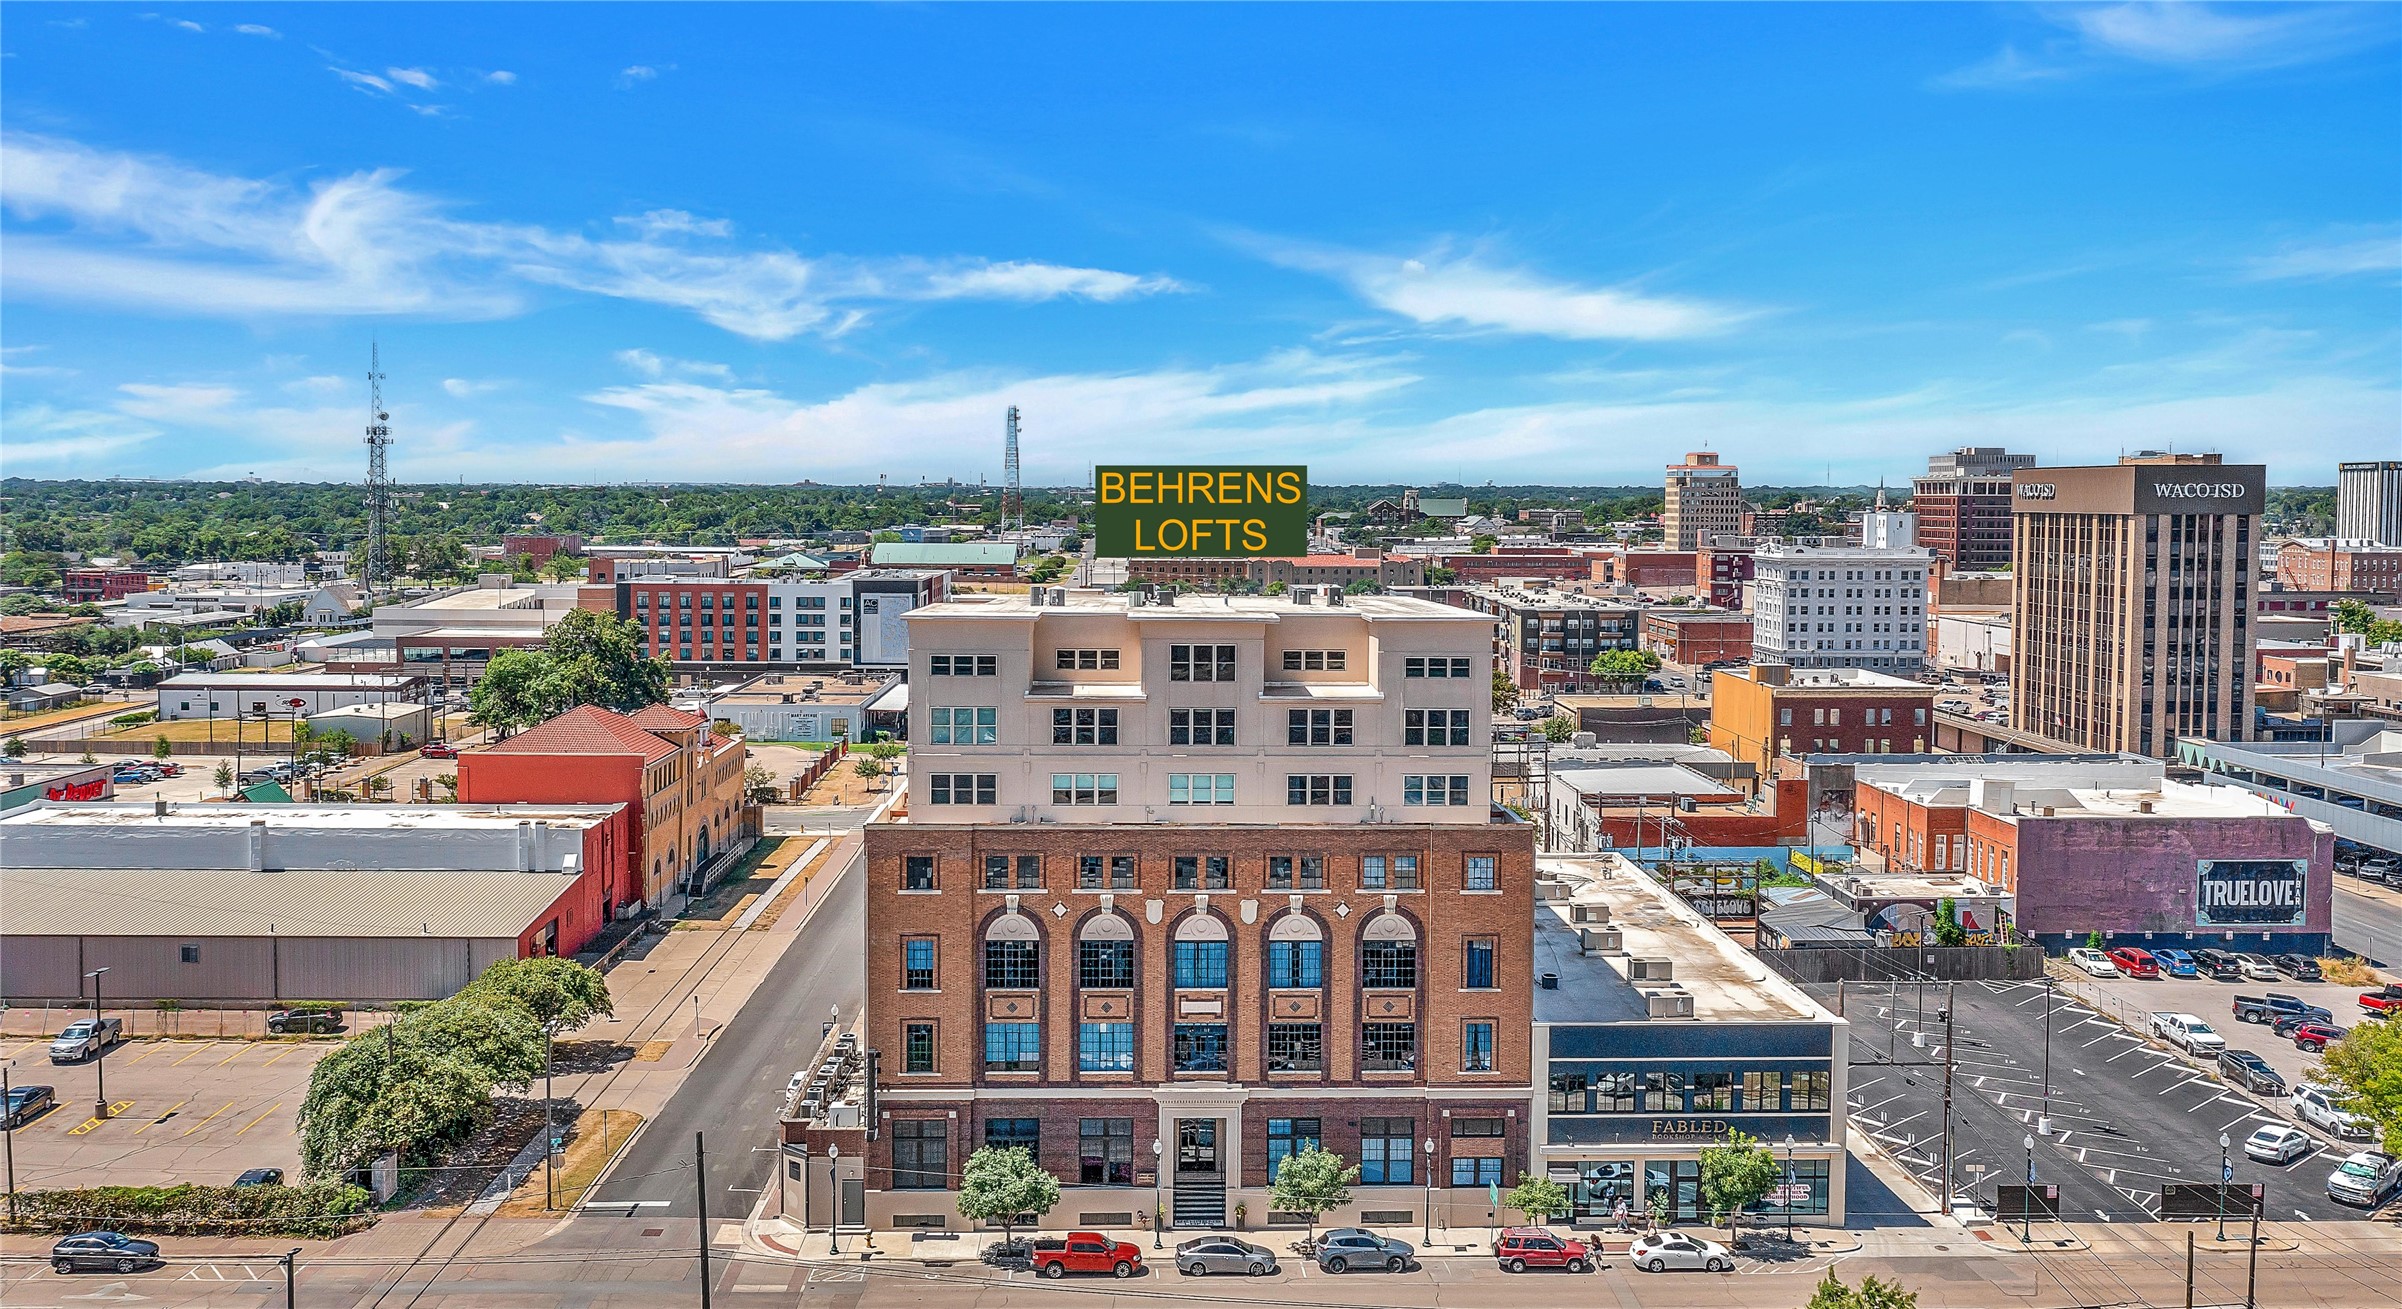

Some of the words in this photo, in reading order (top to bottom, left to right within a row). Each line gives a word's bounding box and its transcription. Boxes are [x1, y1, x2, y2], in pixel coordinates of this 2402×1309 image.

[2016, 483, 2040, 498] WACO
[2153, 482, 2210, 498] WACO
[2213, 482, 2245, 498] ISD
[864, 599, 878, 607] AC
[65, 778, 107, 801] Pepper
[2203, 880, 2295, 906] TRUELOVE
[1652, 1120, 1727, 1133] FABLED
